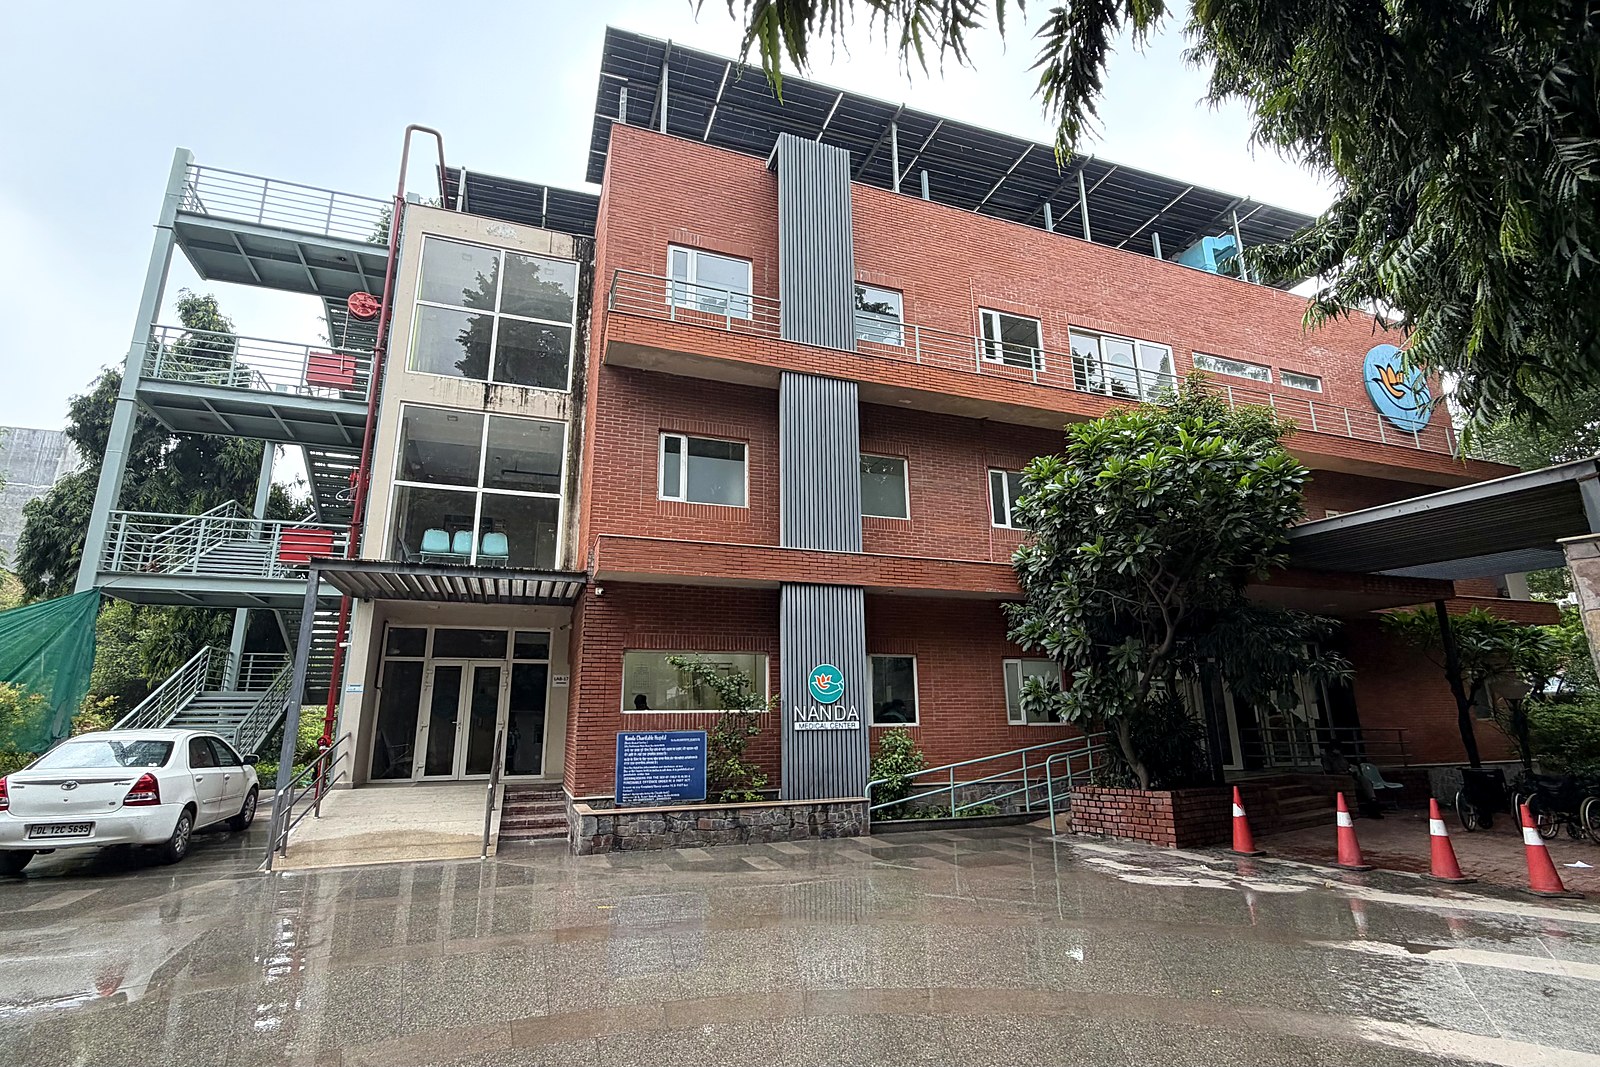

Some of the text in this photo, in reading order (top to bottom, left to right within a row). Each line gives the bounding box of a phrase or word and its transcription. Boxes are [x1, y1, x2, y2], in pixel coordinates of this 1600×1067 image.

[794, 705, 859, 721] NANDA
[36, 825, 89, 835] DL 12C 5695
